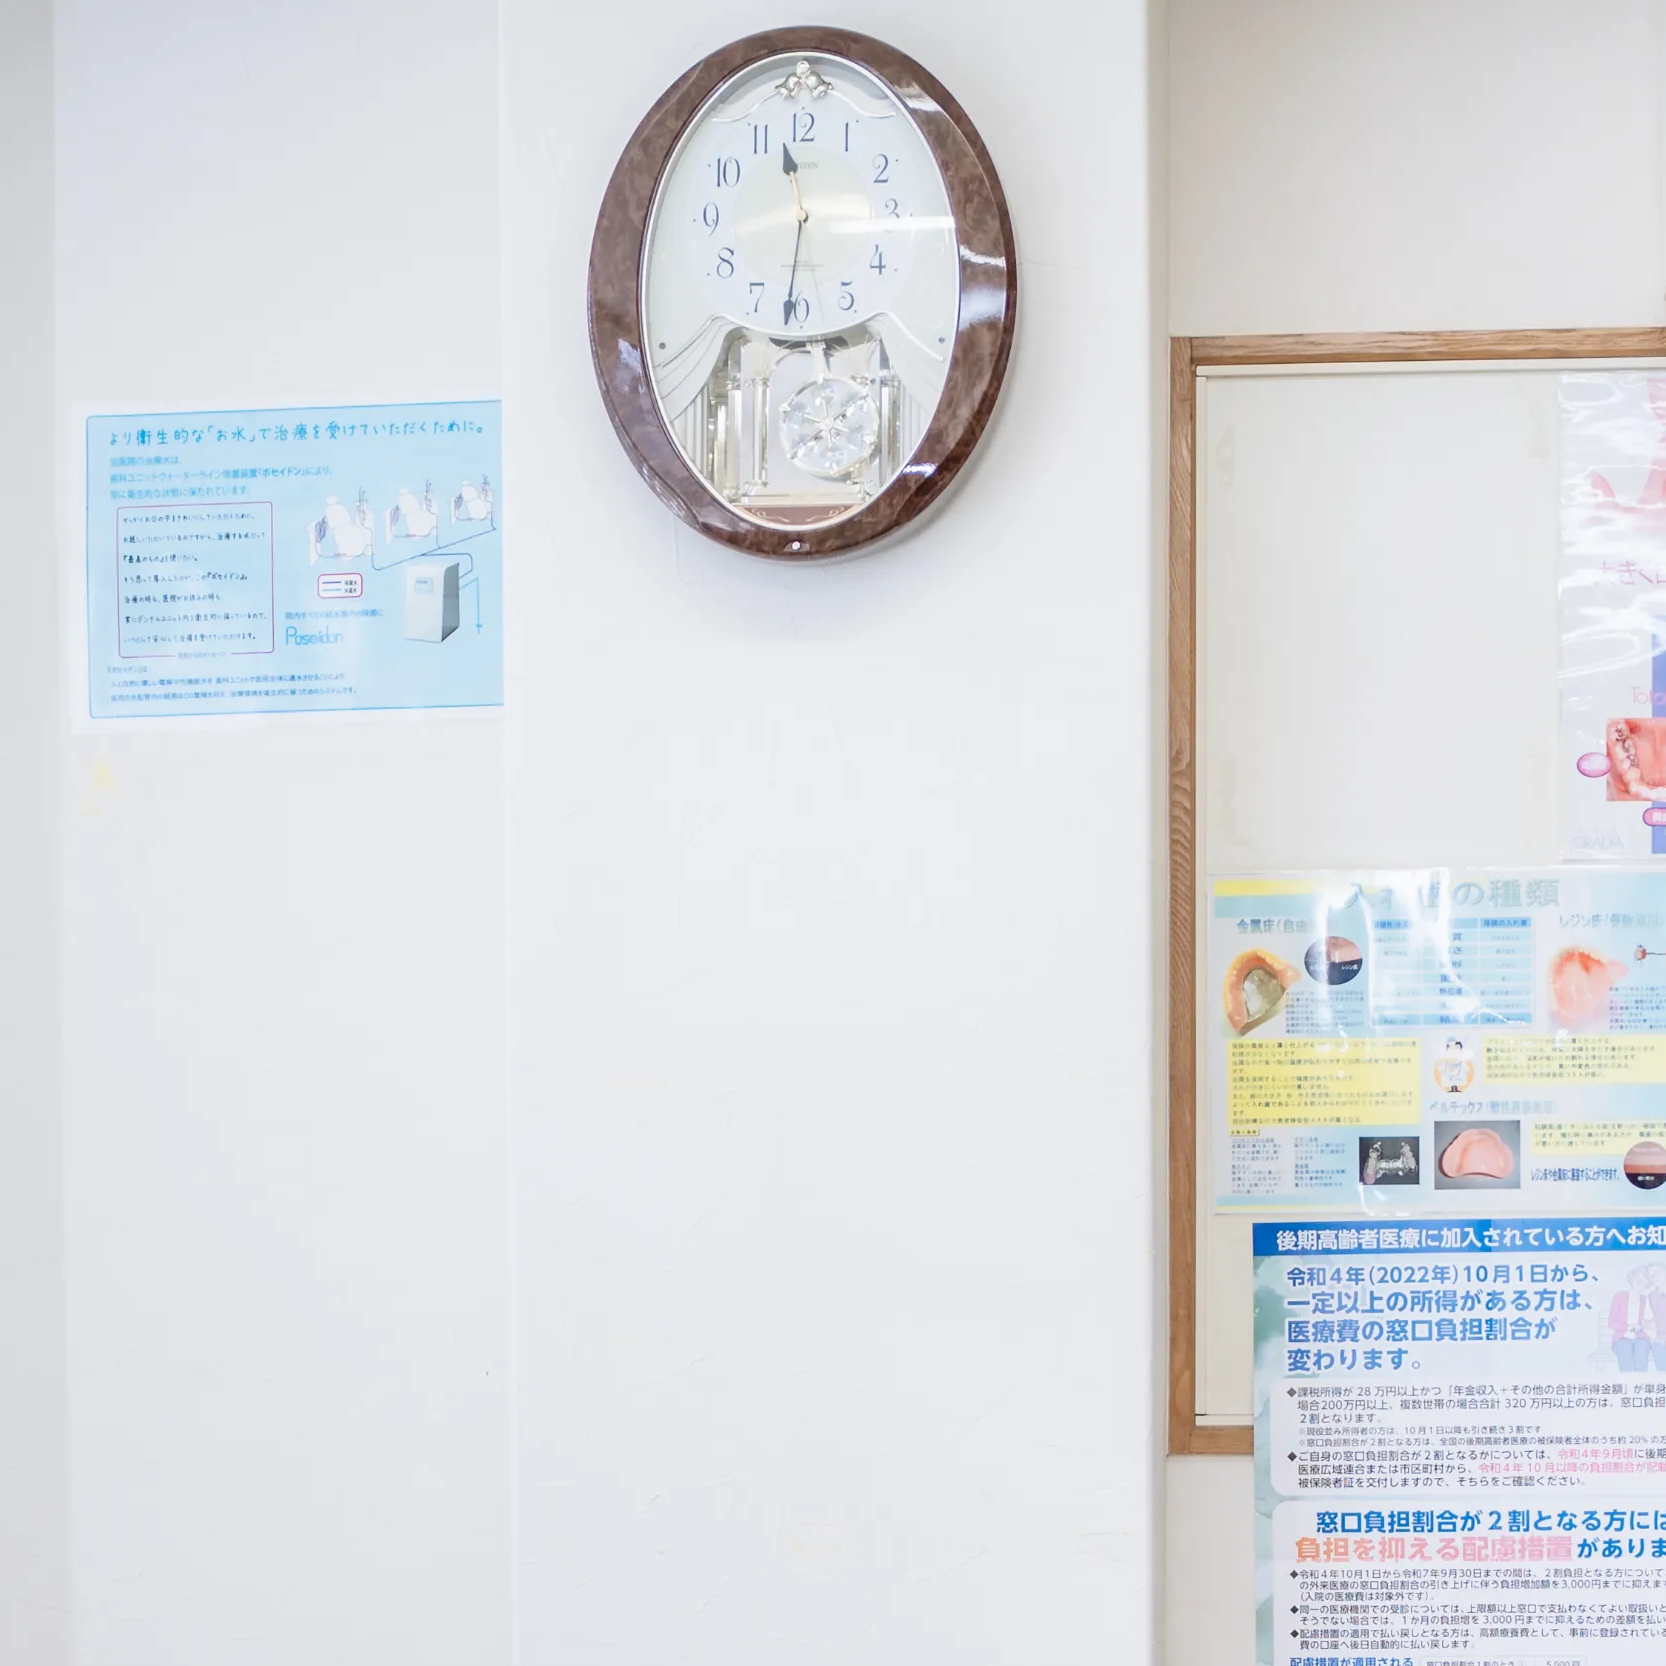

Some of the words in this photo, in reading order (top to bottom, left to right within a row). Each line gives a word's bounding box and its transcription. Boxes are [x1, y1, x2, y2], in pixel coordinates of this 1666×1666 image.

[752, 123, 769, 155] 11
[791, 111, 816, 142] 12
[843, 121, 850, 152] 1
[716, 156, 740, 188] 10
[872, 154, 889, 184] 2
[702, 203, 720, 235] 9
[885, 198, 900, 233] 3
[716, 247, 734, 278] 8
[869, 244, 886, 275] 4
[748, 282, 765, 313] 7
[792, 290, 810, 323] 6
[837, 281, 855, 311] 5
[109, 420, 485, 446] より衛生的な「お水」で治療を受けていただくために。
[285, 624, 344, 647] Poseidon
[1287, 1263, 1600, 1287] 令和4年(2022年)10月1日から、
[1287, 1289, 1594, 1314] 一定以上の所得がある方は、
[1287, 1317, 1556, 1344] 医療費の窓口負担割合が
[1287, 1347, 1421, 1372] 変わります。
[1299, 1412, 1384, 1424] 2割となります。
[1298, 1475, 1588, 1490] 被保険者証を交付しますので、そちらをご確認ください。
[1301, 1590, 1434, 1602] (入院の医療費は対象外です)。
[1299, 1639, 1475, 1651] 費の口座へ後日自動的に払い戻します。
